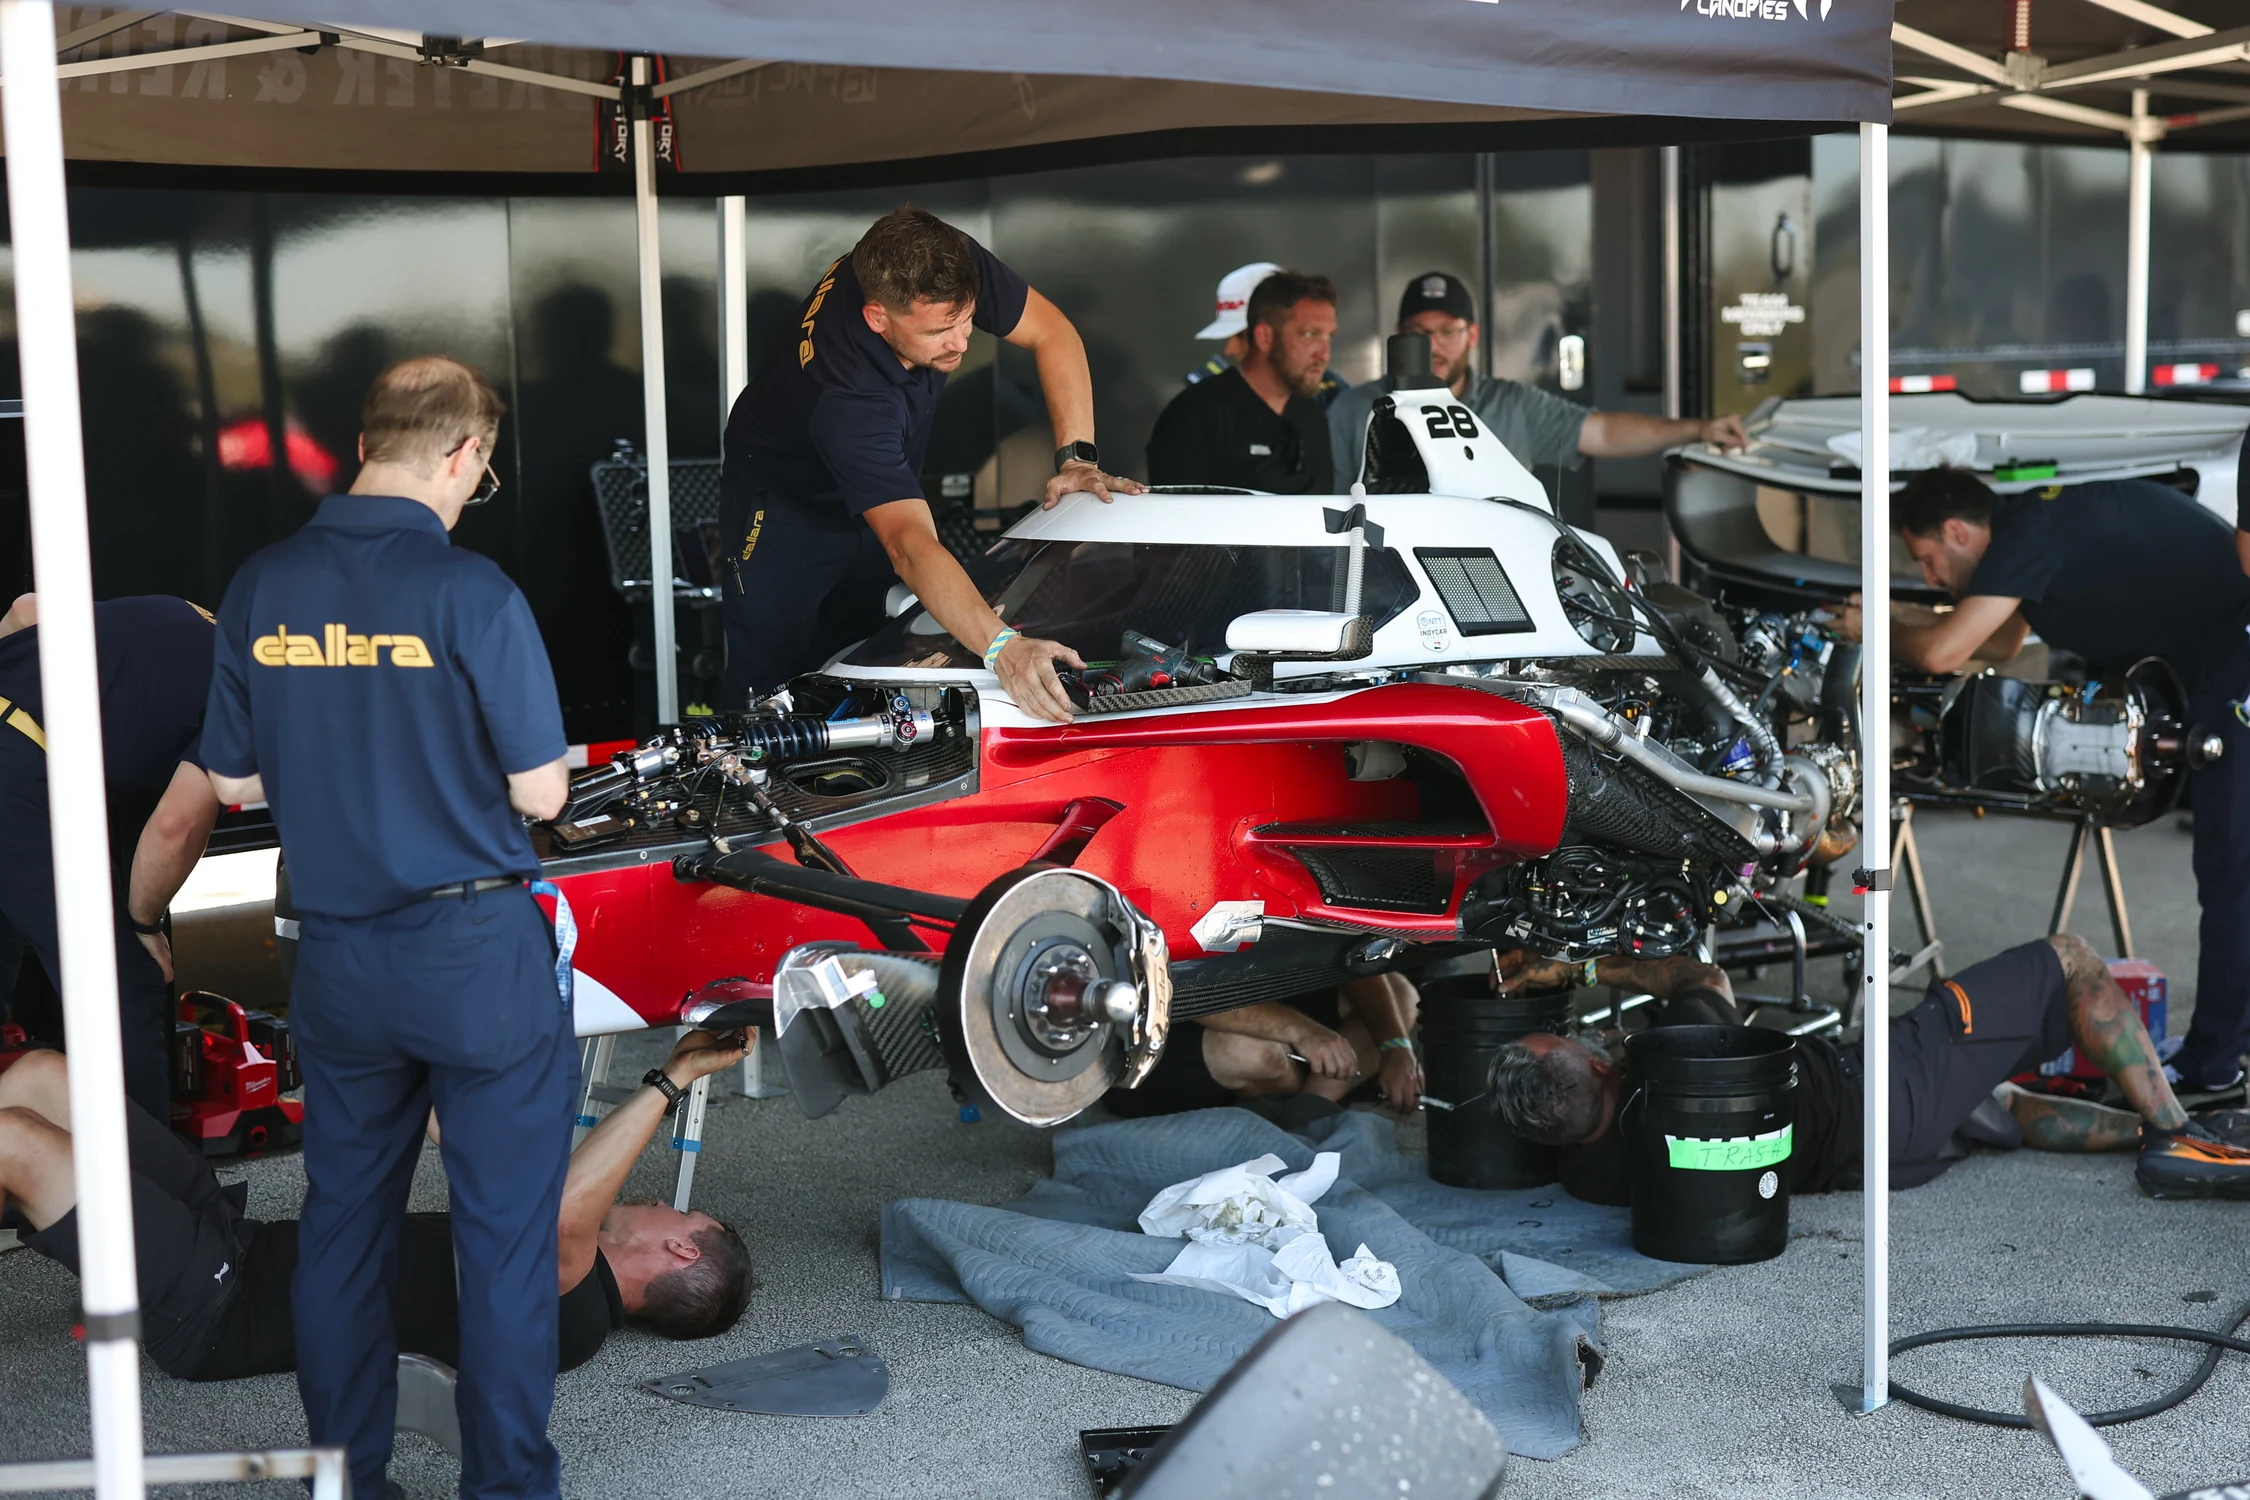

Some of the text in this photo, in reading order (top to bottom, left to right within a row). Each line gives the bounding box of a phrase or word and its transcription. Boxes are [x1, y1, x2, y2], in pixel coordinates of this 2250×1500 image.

[1697, 0, 1789, 21] CANOPIES
[614, 75, 629, 163] FTORY
[1420, 405, 1479, 439] 28
[742, 510, 765, 561] dallara
[252, 623, 435, 668] dallara
[1420, 628, 1448, 637] INDYCAR
[1699, 1141, 1783, 1168] TRASH
